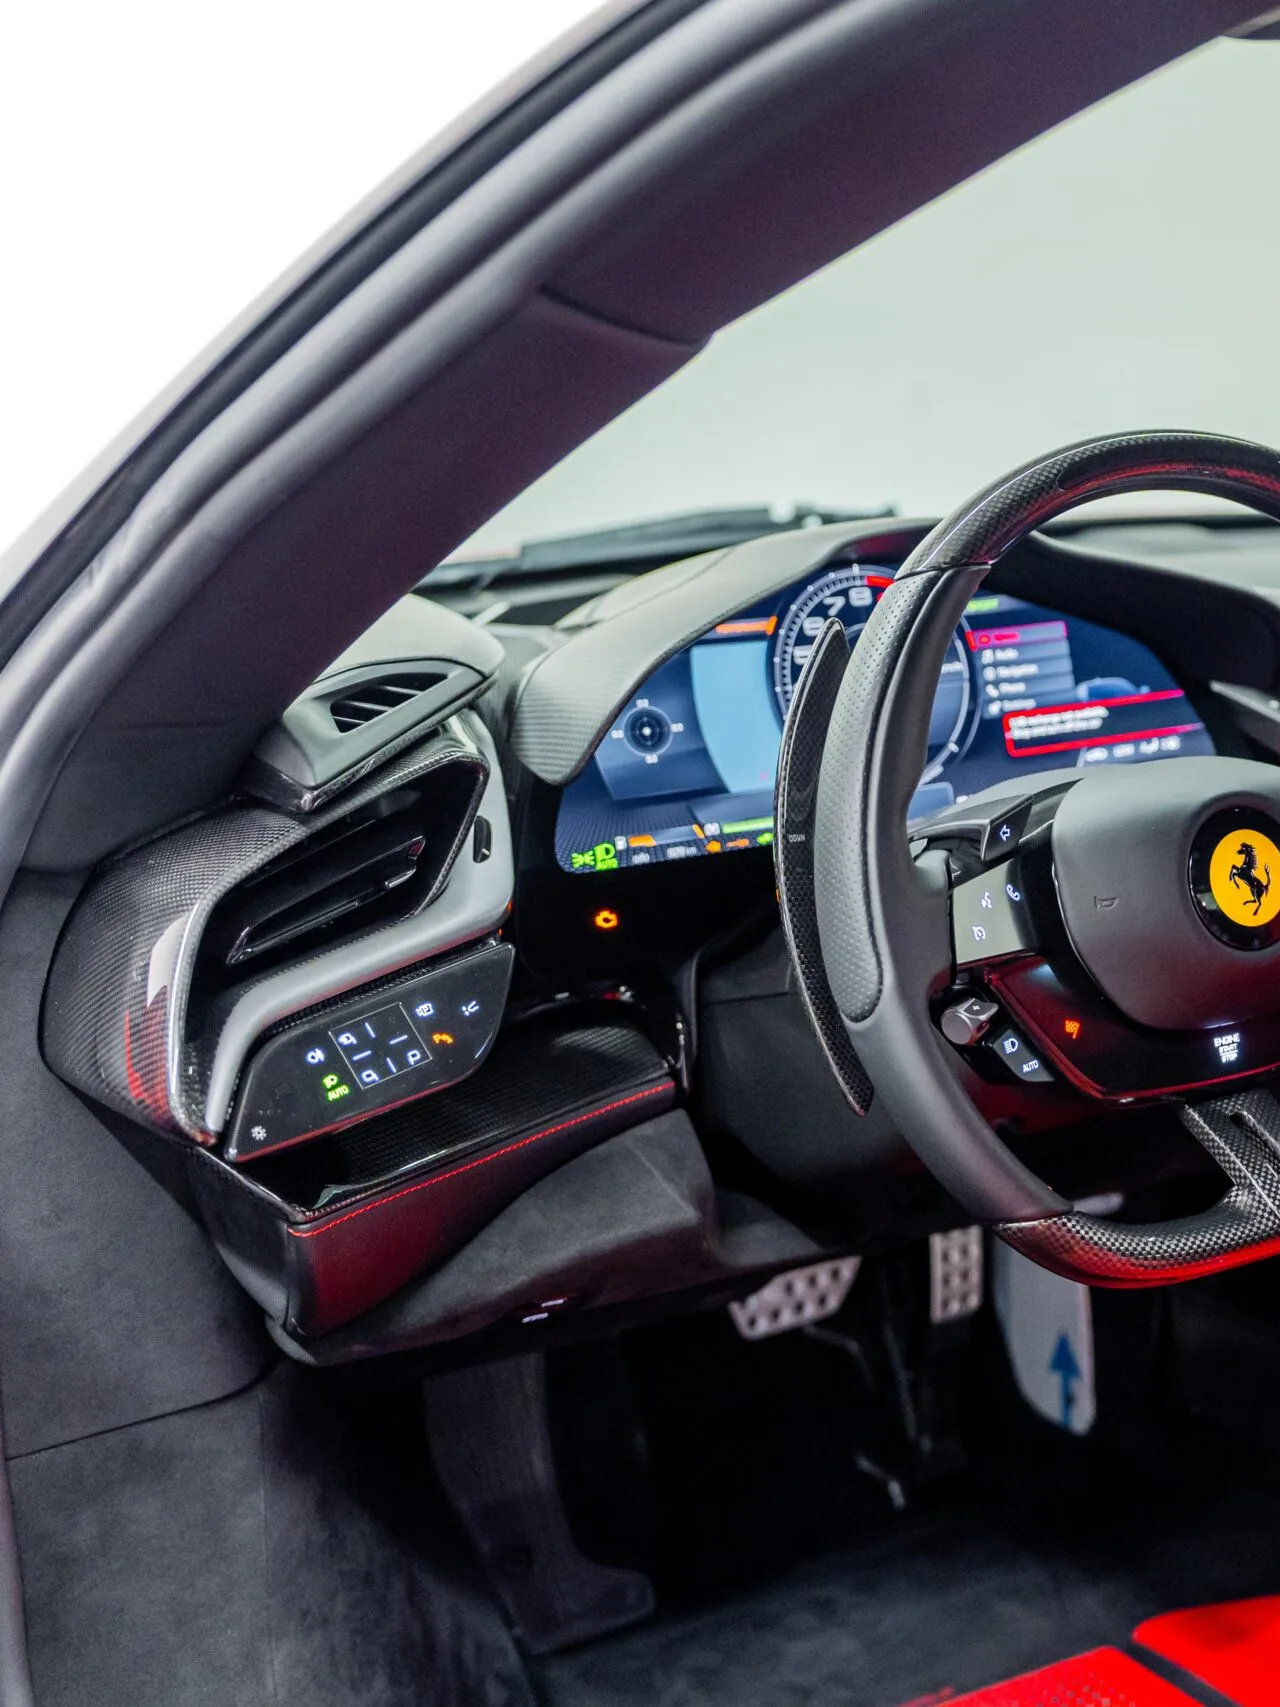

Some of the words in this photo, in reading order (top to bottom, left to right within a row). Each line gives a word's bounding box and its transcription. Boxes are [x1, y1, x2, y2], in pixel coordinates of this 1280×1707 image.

[848, 586, 873, 607] 8
[822, 595, 846, 616] 7
[595, 858, 618, 871] AUTO
[1213, 1032, 1240, 1048] ENGINE
[1218, 1043, 1238, 1054] START
[1221, 1052, 1238, 1063] STOP
[1022, 1060, 1039, 1073] AUTO
[327, 1085, 350, 1101] AUTO
